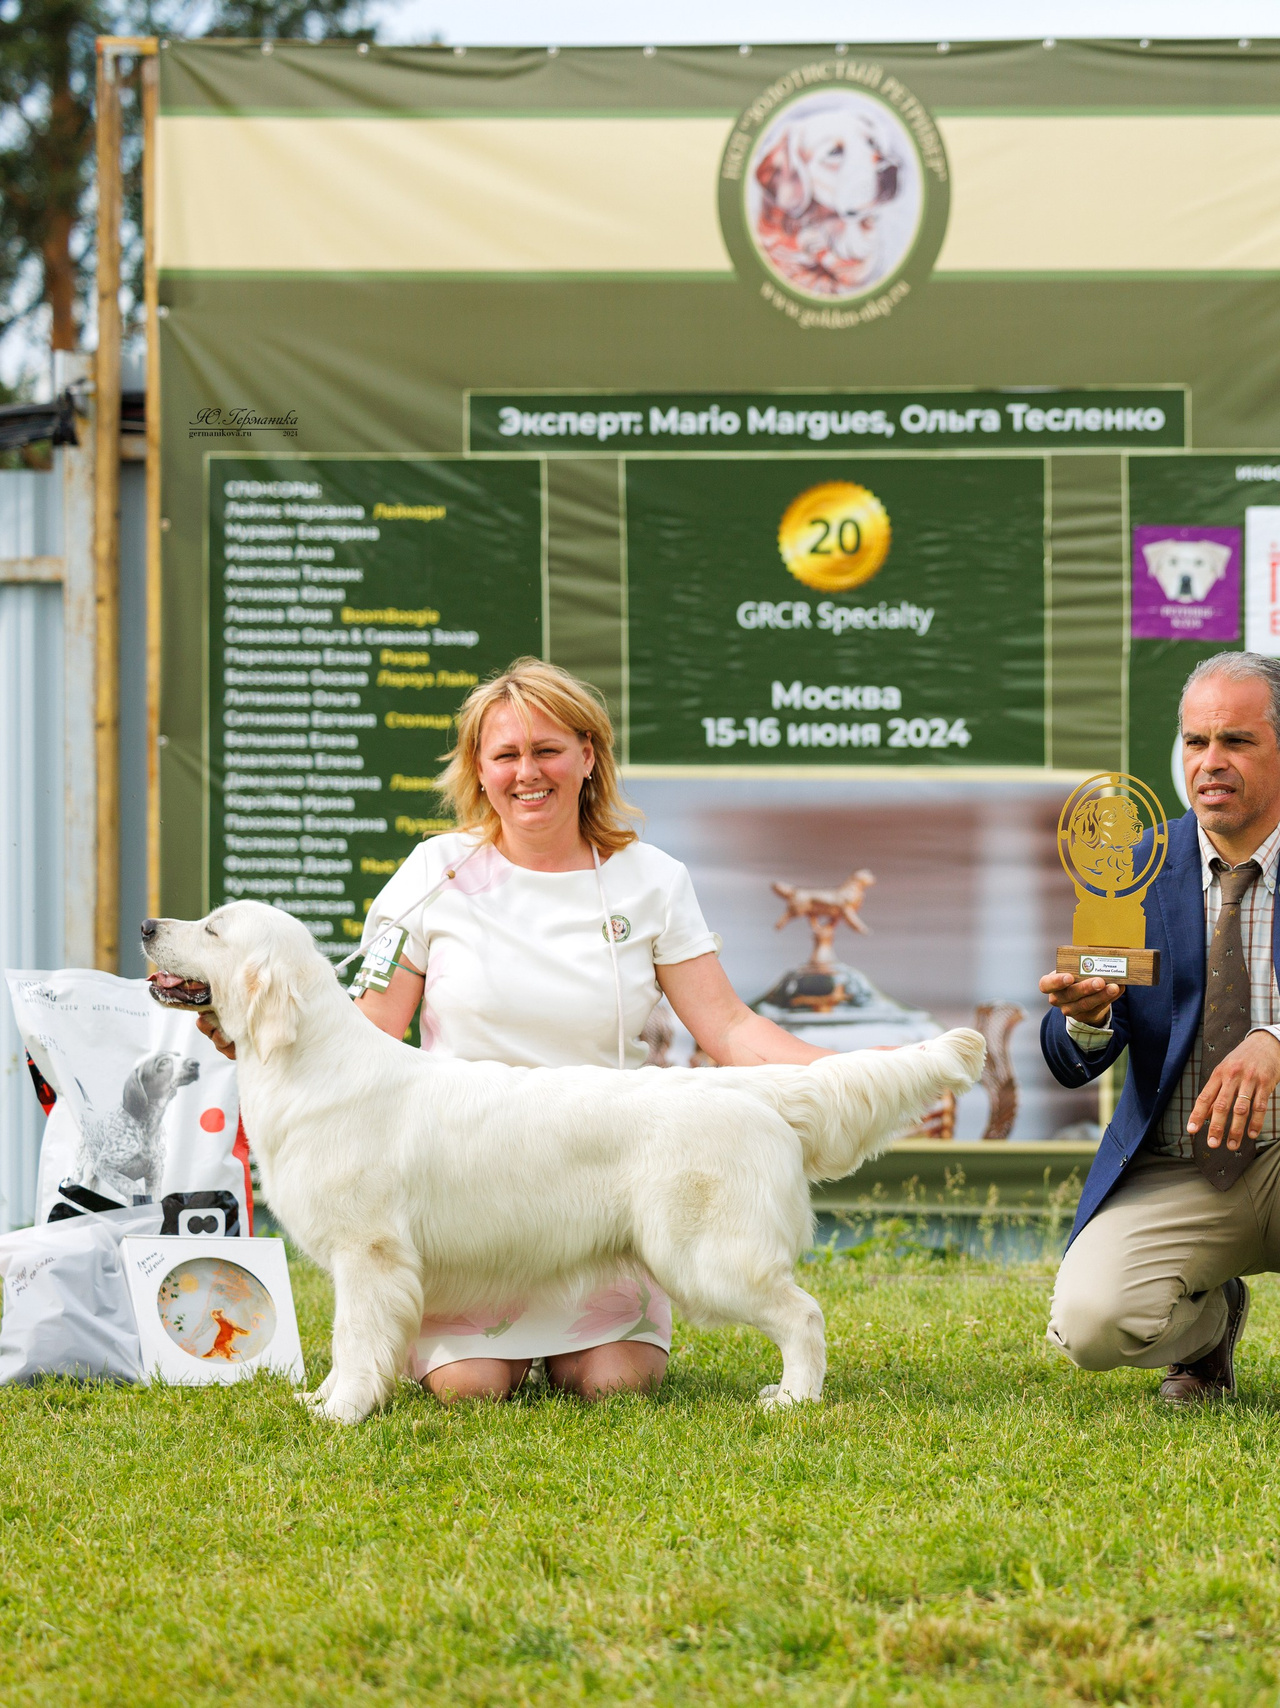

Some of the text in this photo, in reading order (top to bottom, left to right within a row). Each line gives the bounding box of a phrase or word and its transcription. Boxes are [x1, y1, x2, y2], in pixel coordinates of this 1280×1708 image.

[498, 402, 1166, 441] Эксперт: Mario Margues, Ольга Тесленко
[808, 518, 862, 556] 20
[737, 600, 934, 636] GRCR Specialty
[771, 681, 902, 710] Москва
[702, 717, 971, 749] 15-16 июня 2024
